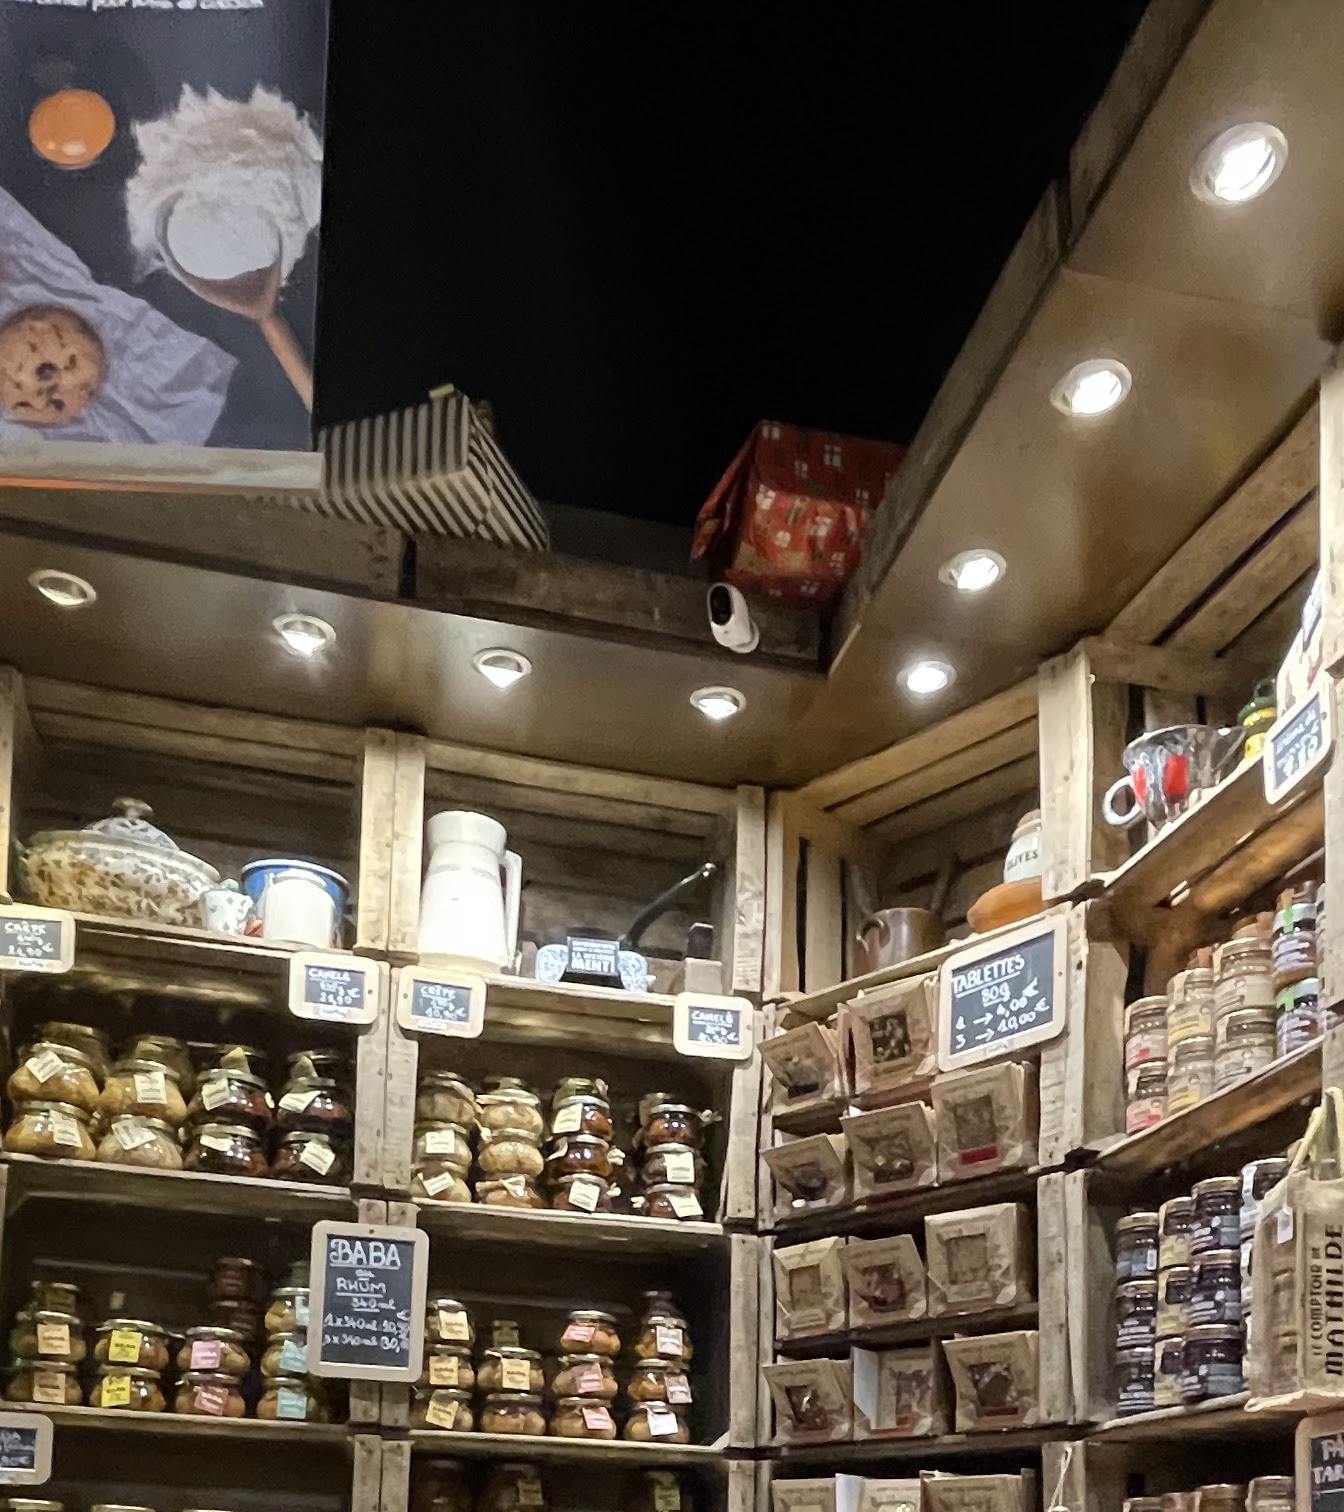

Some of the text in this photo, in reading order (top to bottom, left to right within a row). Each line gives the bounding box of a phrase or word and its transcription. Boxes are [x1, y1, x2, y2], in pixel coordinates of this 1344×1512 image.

[951, 954, 1025, 994] TABLETTES
[329, 1239, 401, 1267] BABA
[336, 1277, 386, 1294] RHUM
[1311, 1266, 1323, 1338] COMPTOIR
[1324, 1224, 1344, 1376] MATHILDE
